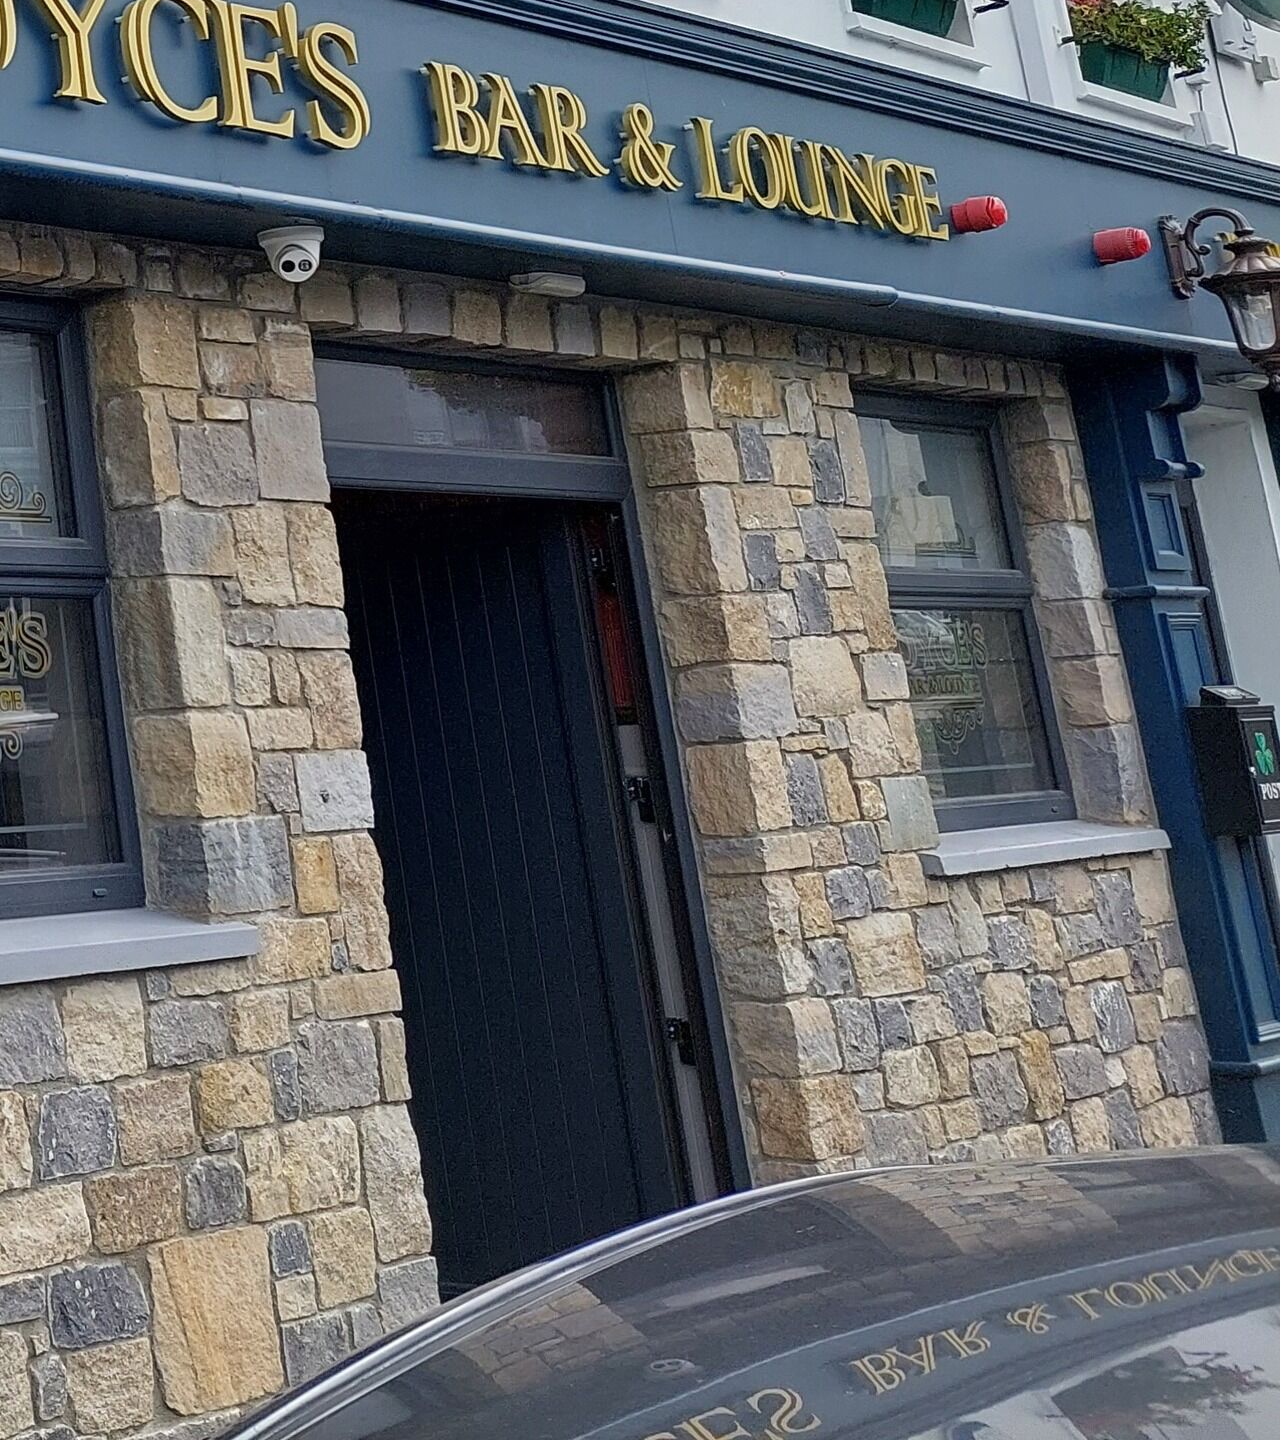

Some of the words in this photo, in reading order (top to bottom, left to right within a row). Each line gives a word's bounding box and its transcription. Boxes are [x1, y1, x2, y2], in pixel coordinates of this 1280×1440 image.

[425, 61, 610, 178] BAR
[619, 102, 683, 192] &
[687, 116, 950, 242] LOUNGE
